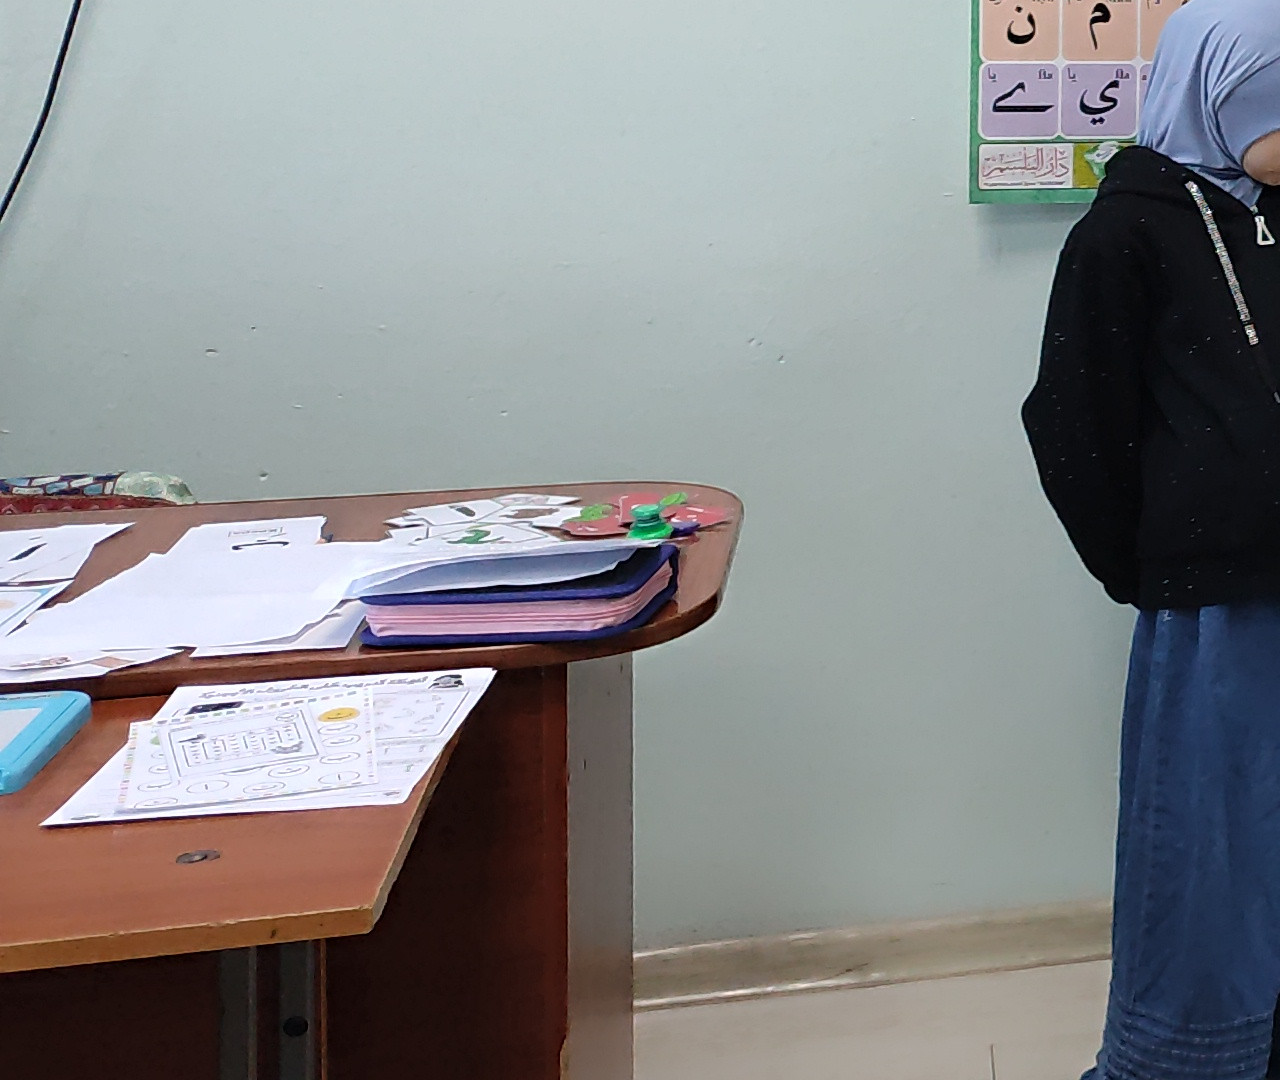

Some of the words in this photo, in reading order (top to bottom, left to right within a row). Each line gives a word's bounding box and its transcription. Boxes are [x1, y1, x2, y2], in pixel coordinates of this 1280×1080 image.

[1007, 5, 1036, 44] ن
[1090, 3, 1111, 50] م
[1080, 80, 1120, 125] ي
